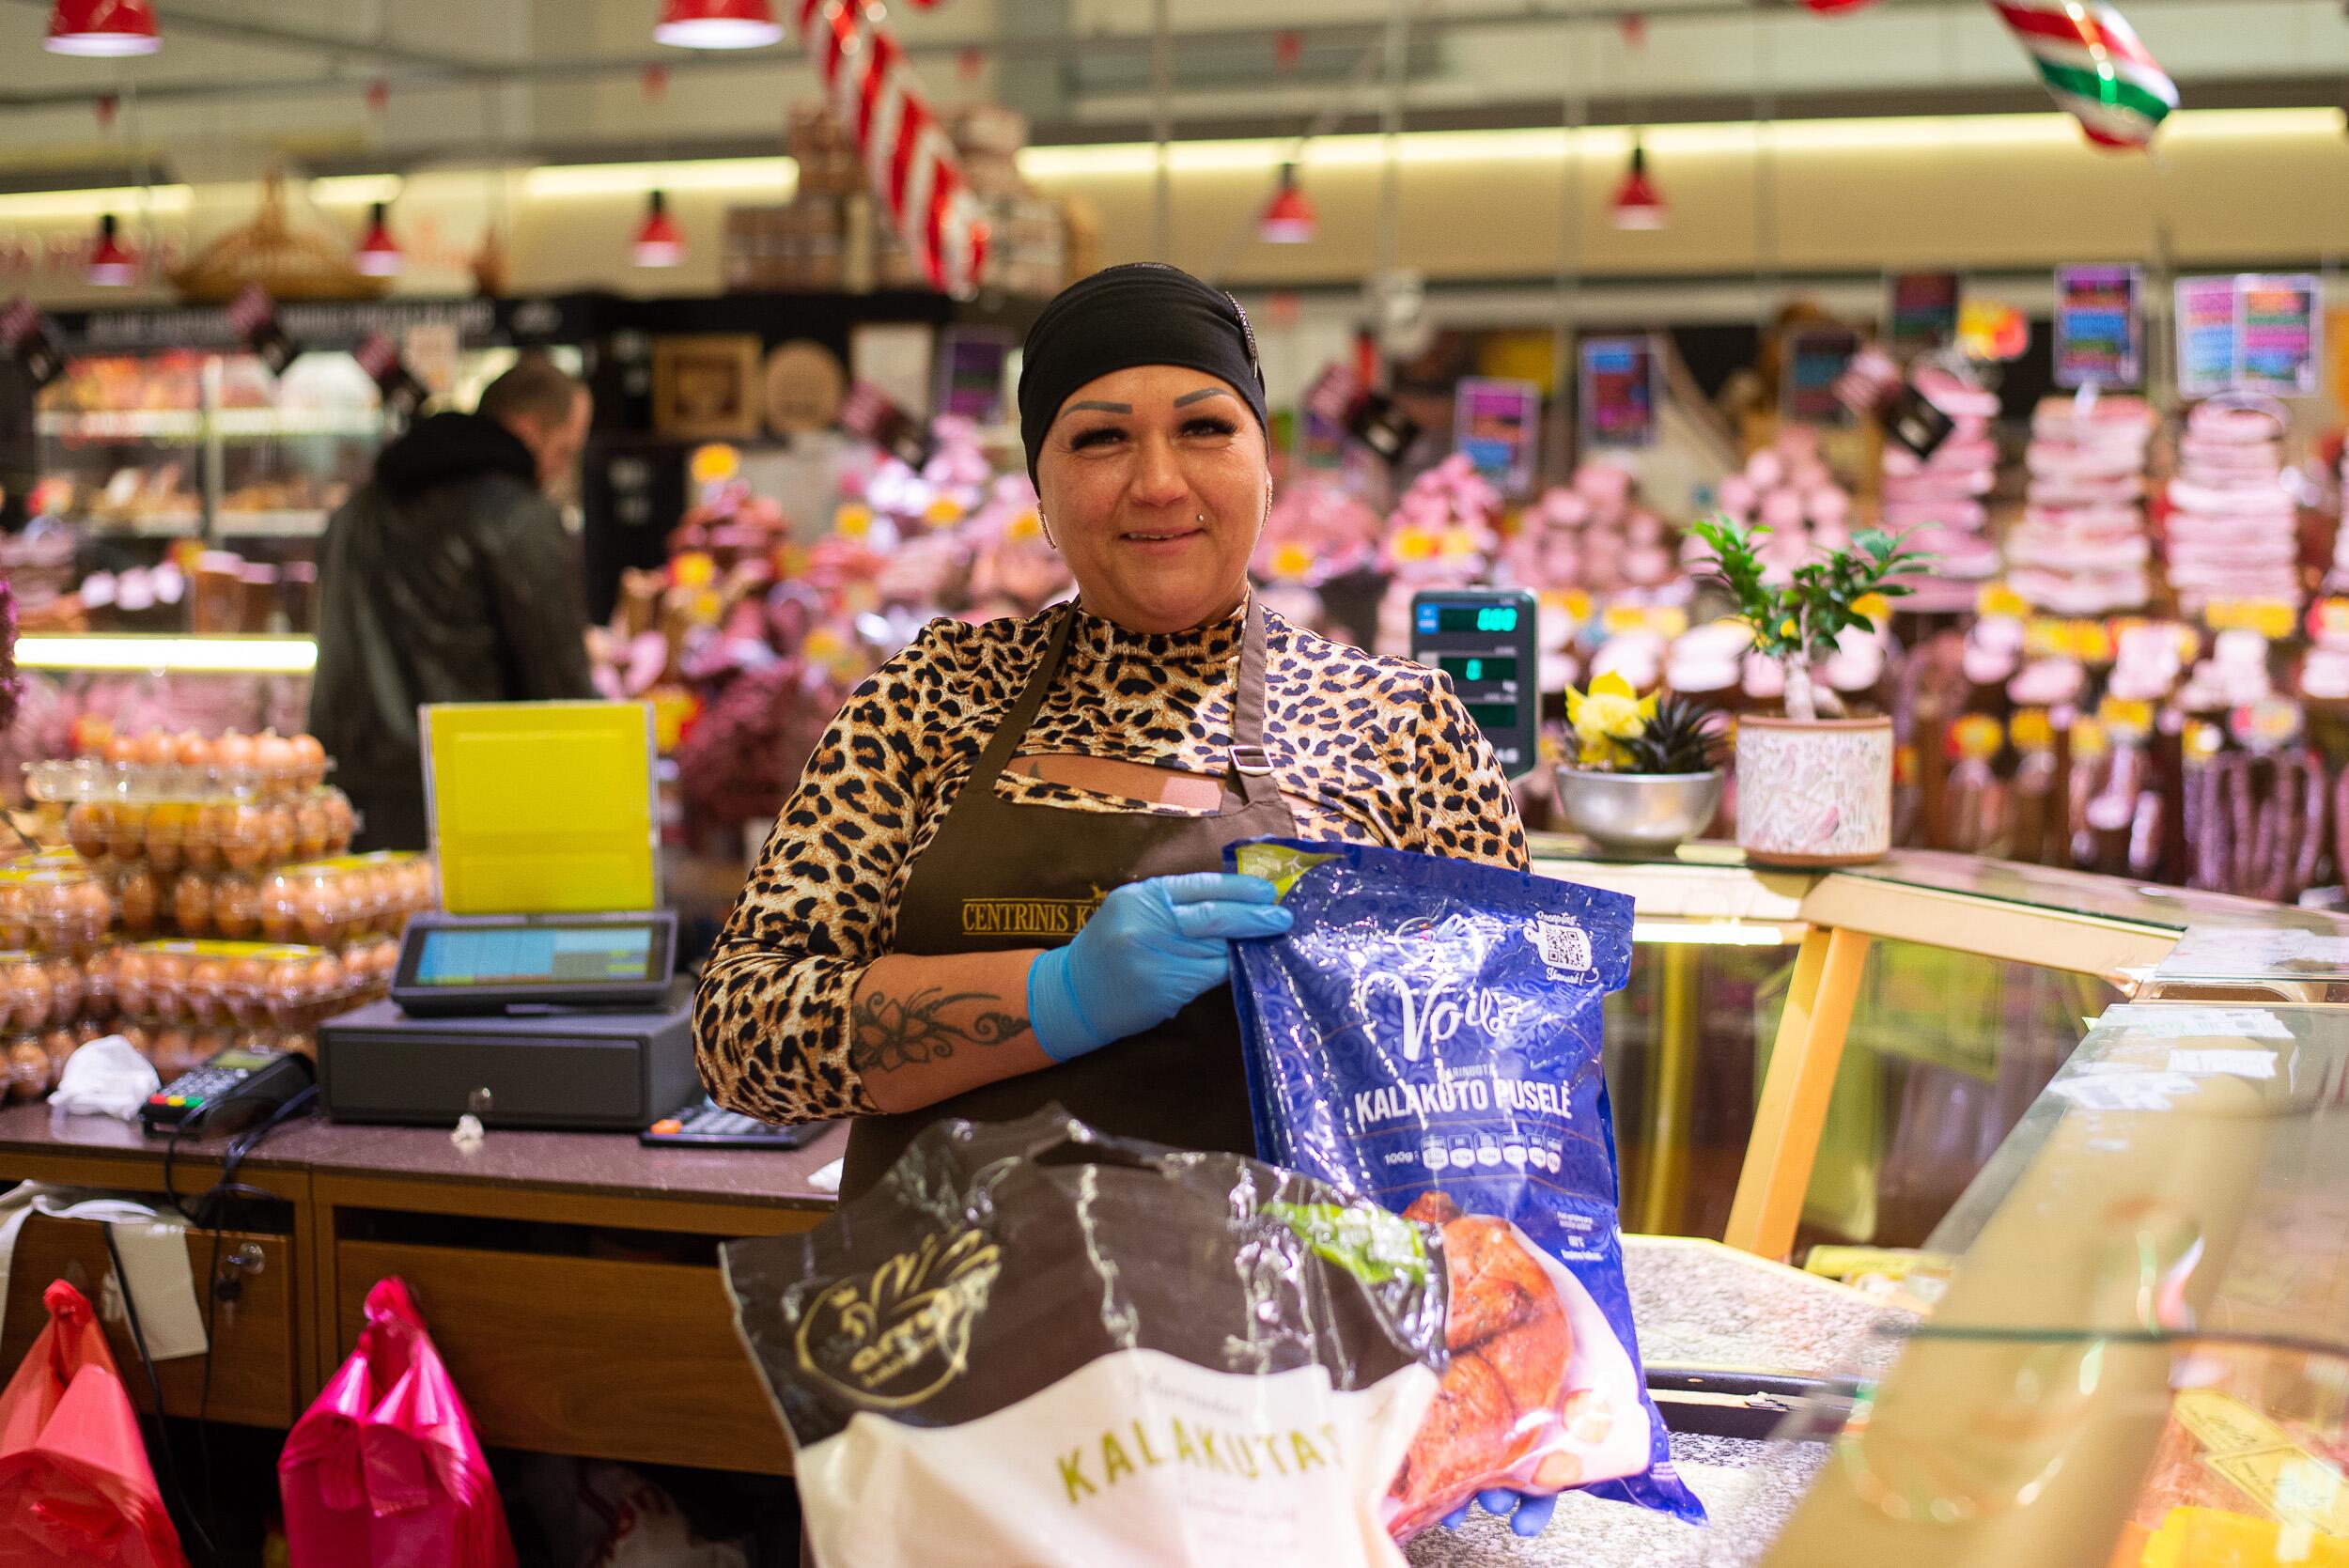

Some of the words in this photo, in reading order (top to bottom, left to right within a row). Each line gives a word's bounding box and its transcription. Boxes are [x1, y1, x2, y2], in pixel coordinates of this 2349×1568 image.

[962, 903, 1069, 933] CENTRINIS
[1354, 1079, 1489, 1124] KALAKUTO
[1492, 1079, 1573, 1120] PUSELĖ
